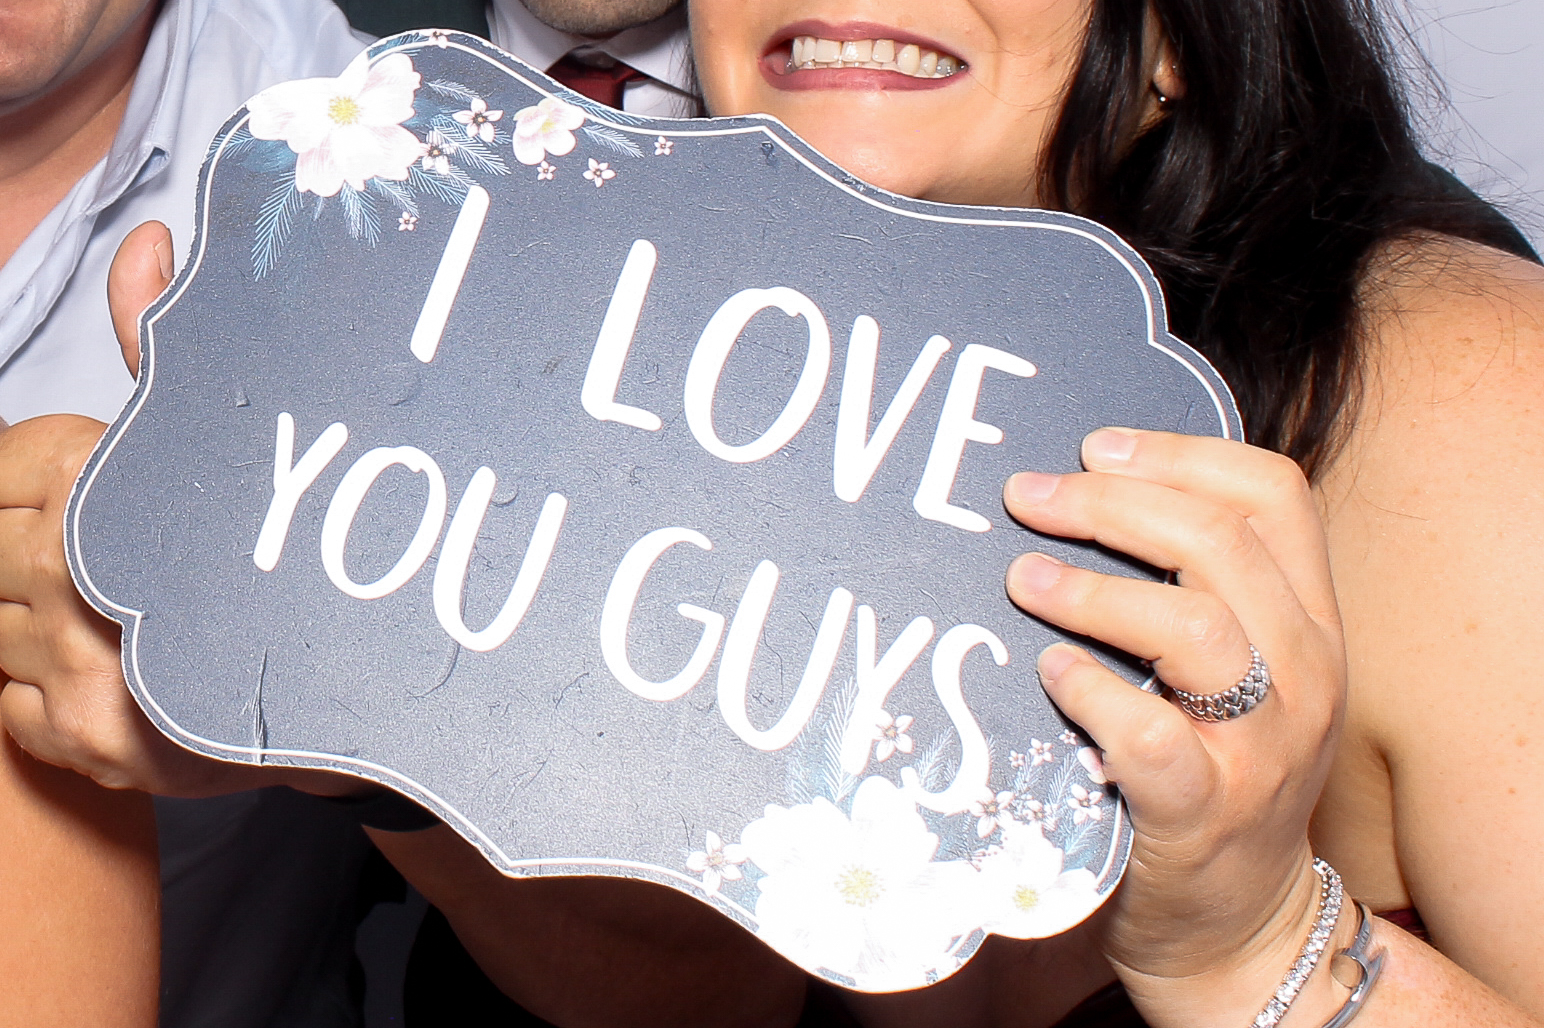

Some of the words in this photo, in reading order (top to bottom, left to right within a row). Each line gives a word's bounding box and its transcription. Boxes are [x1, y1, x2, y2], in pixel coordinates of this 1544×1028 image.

[410, 184, 490, 363] I
[581, 239, 1038, 532] LOVE
[253, 412, 568, 652] YOU
[599, 526, 1010, 816] GUYS
